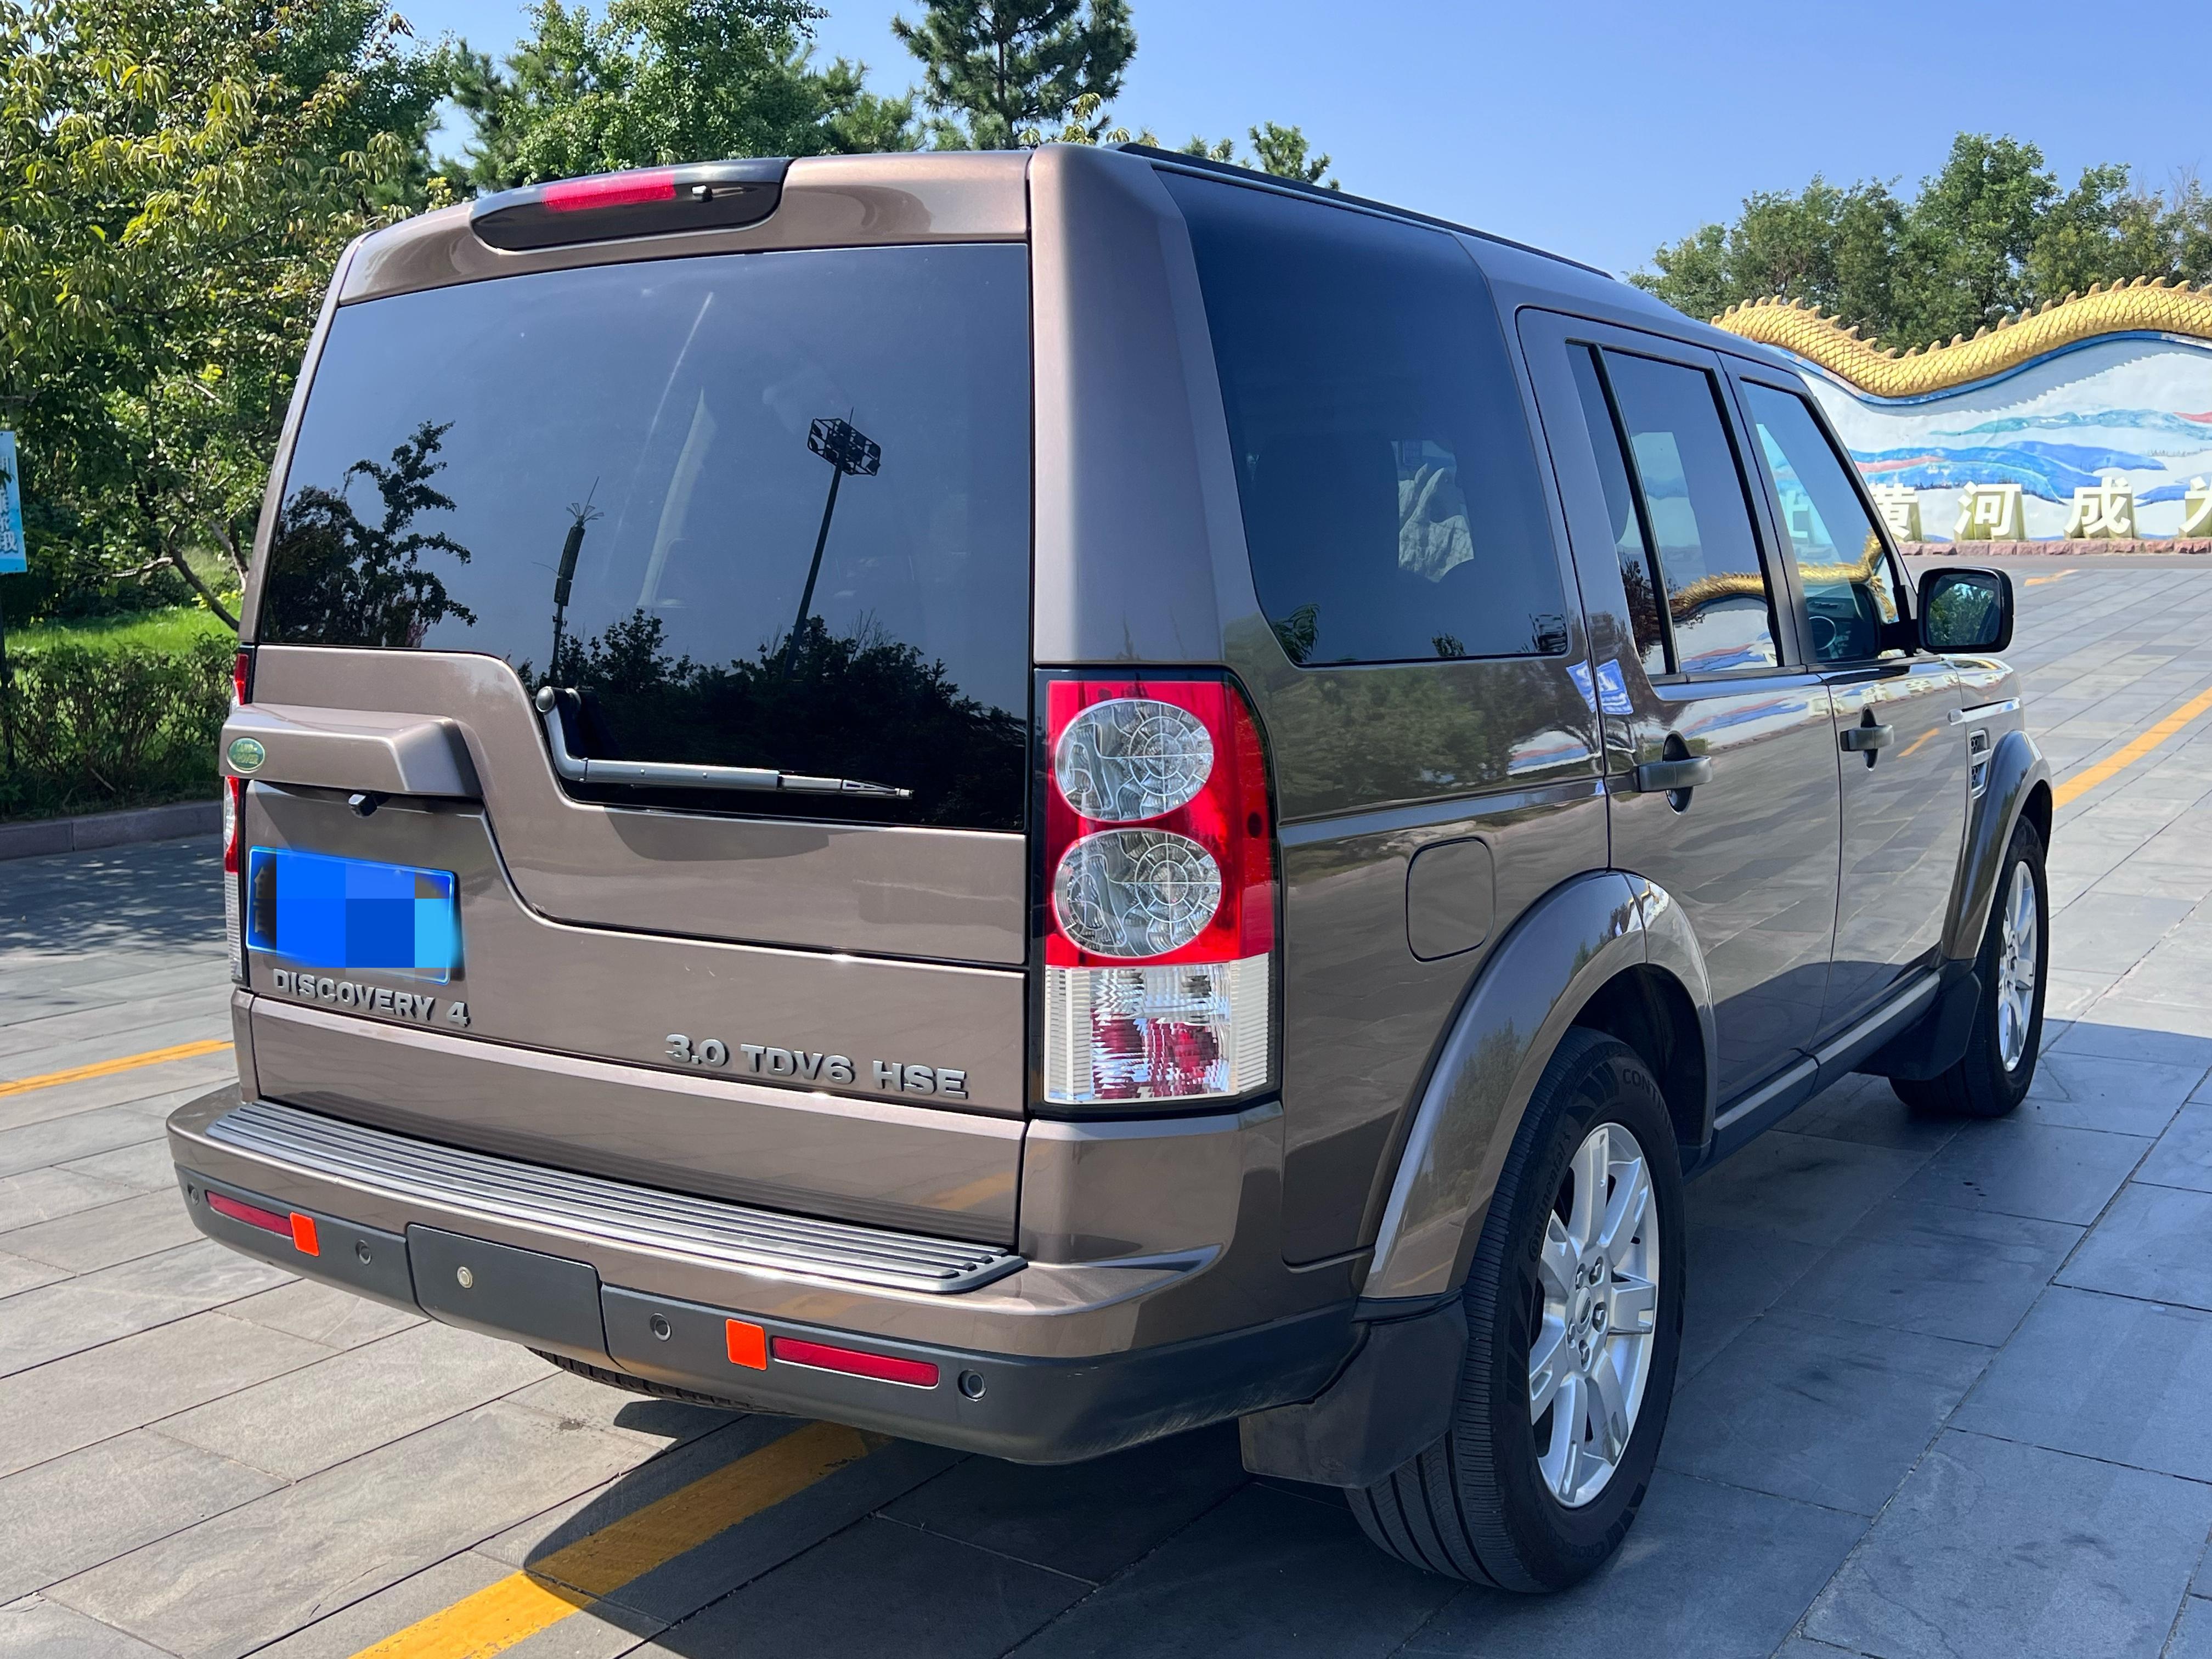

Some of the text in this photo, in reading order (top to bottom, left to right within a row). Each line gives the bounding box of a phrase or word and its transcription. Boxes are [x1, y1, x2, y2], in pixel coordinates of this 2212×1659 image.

[273, 968, 471, 1028] DISCOVERY 4
[665, 1033, 969, 1099] 3.0 TDV6 HSE
